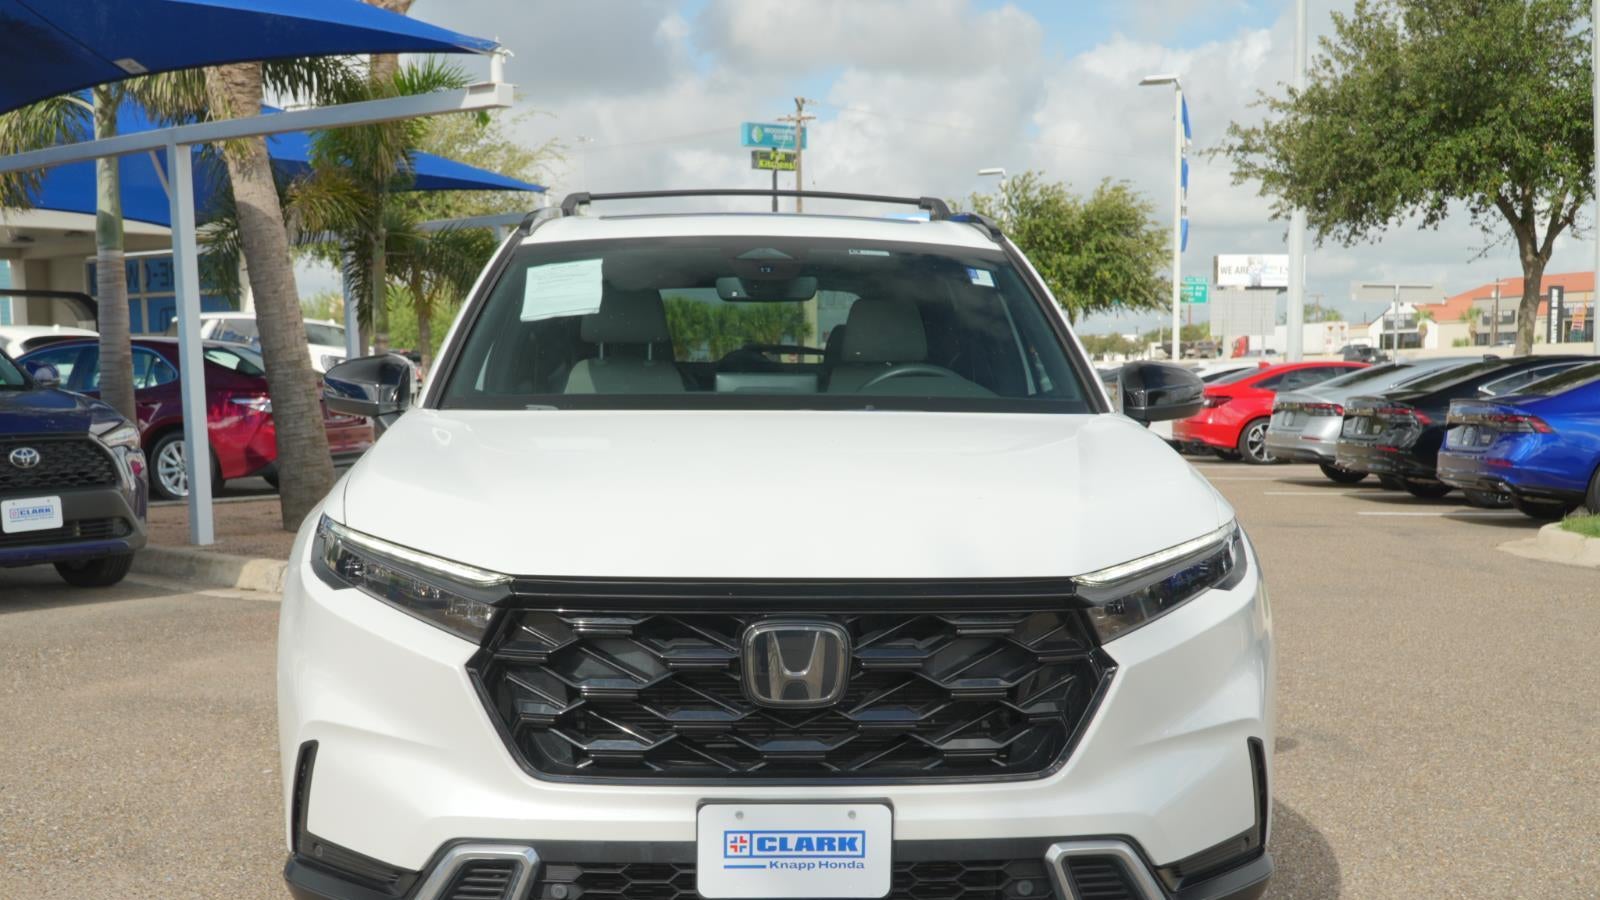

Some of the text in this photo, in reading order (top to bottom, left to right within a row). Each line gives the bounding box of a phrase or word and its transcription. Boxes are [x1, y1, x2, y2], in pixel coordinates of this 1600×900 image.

[1220, 266, 1232, 274] WE
[20, 507, 51, 516] CLARK
[756, 836, 859, 852] CLARK
[769, 860, 865, 871] Knapp Honda
